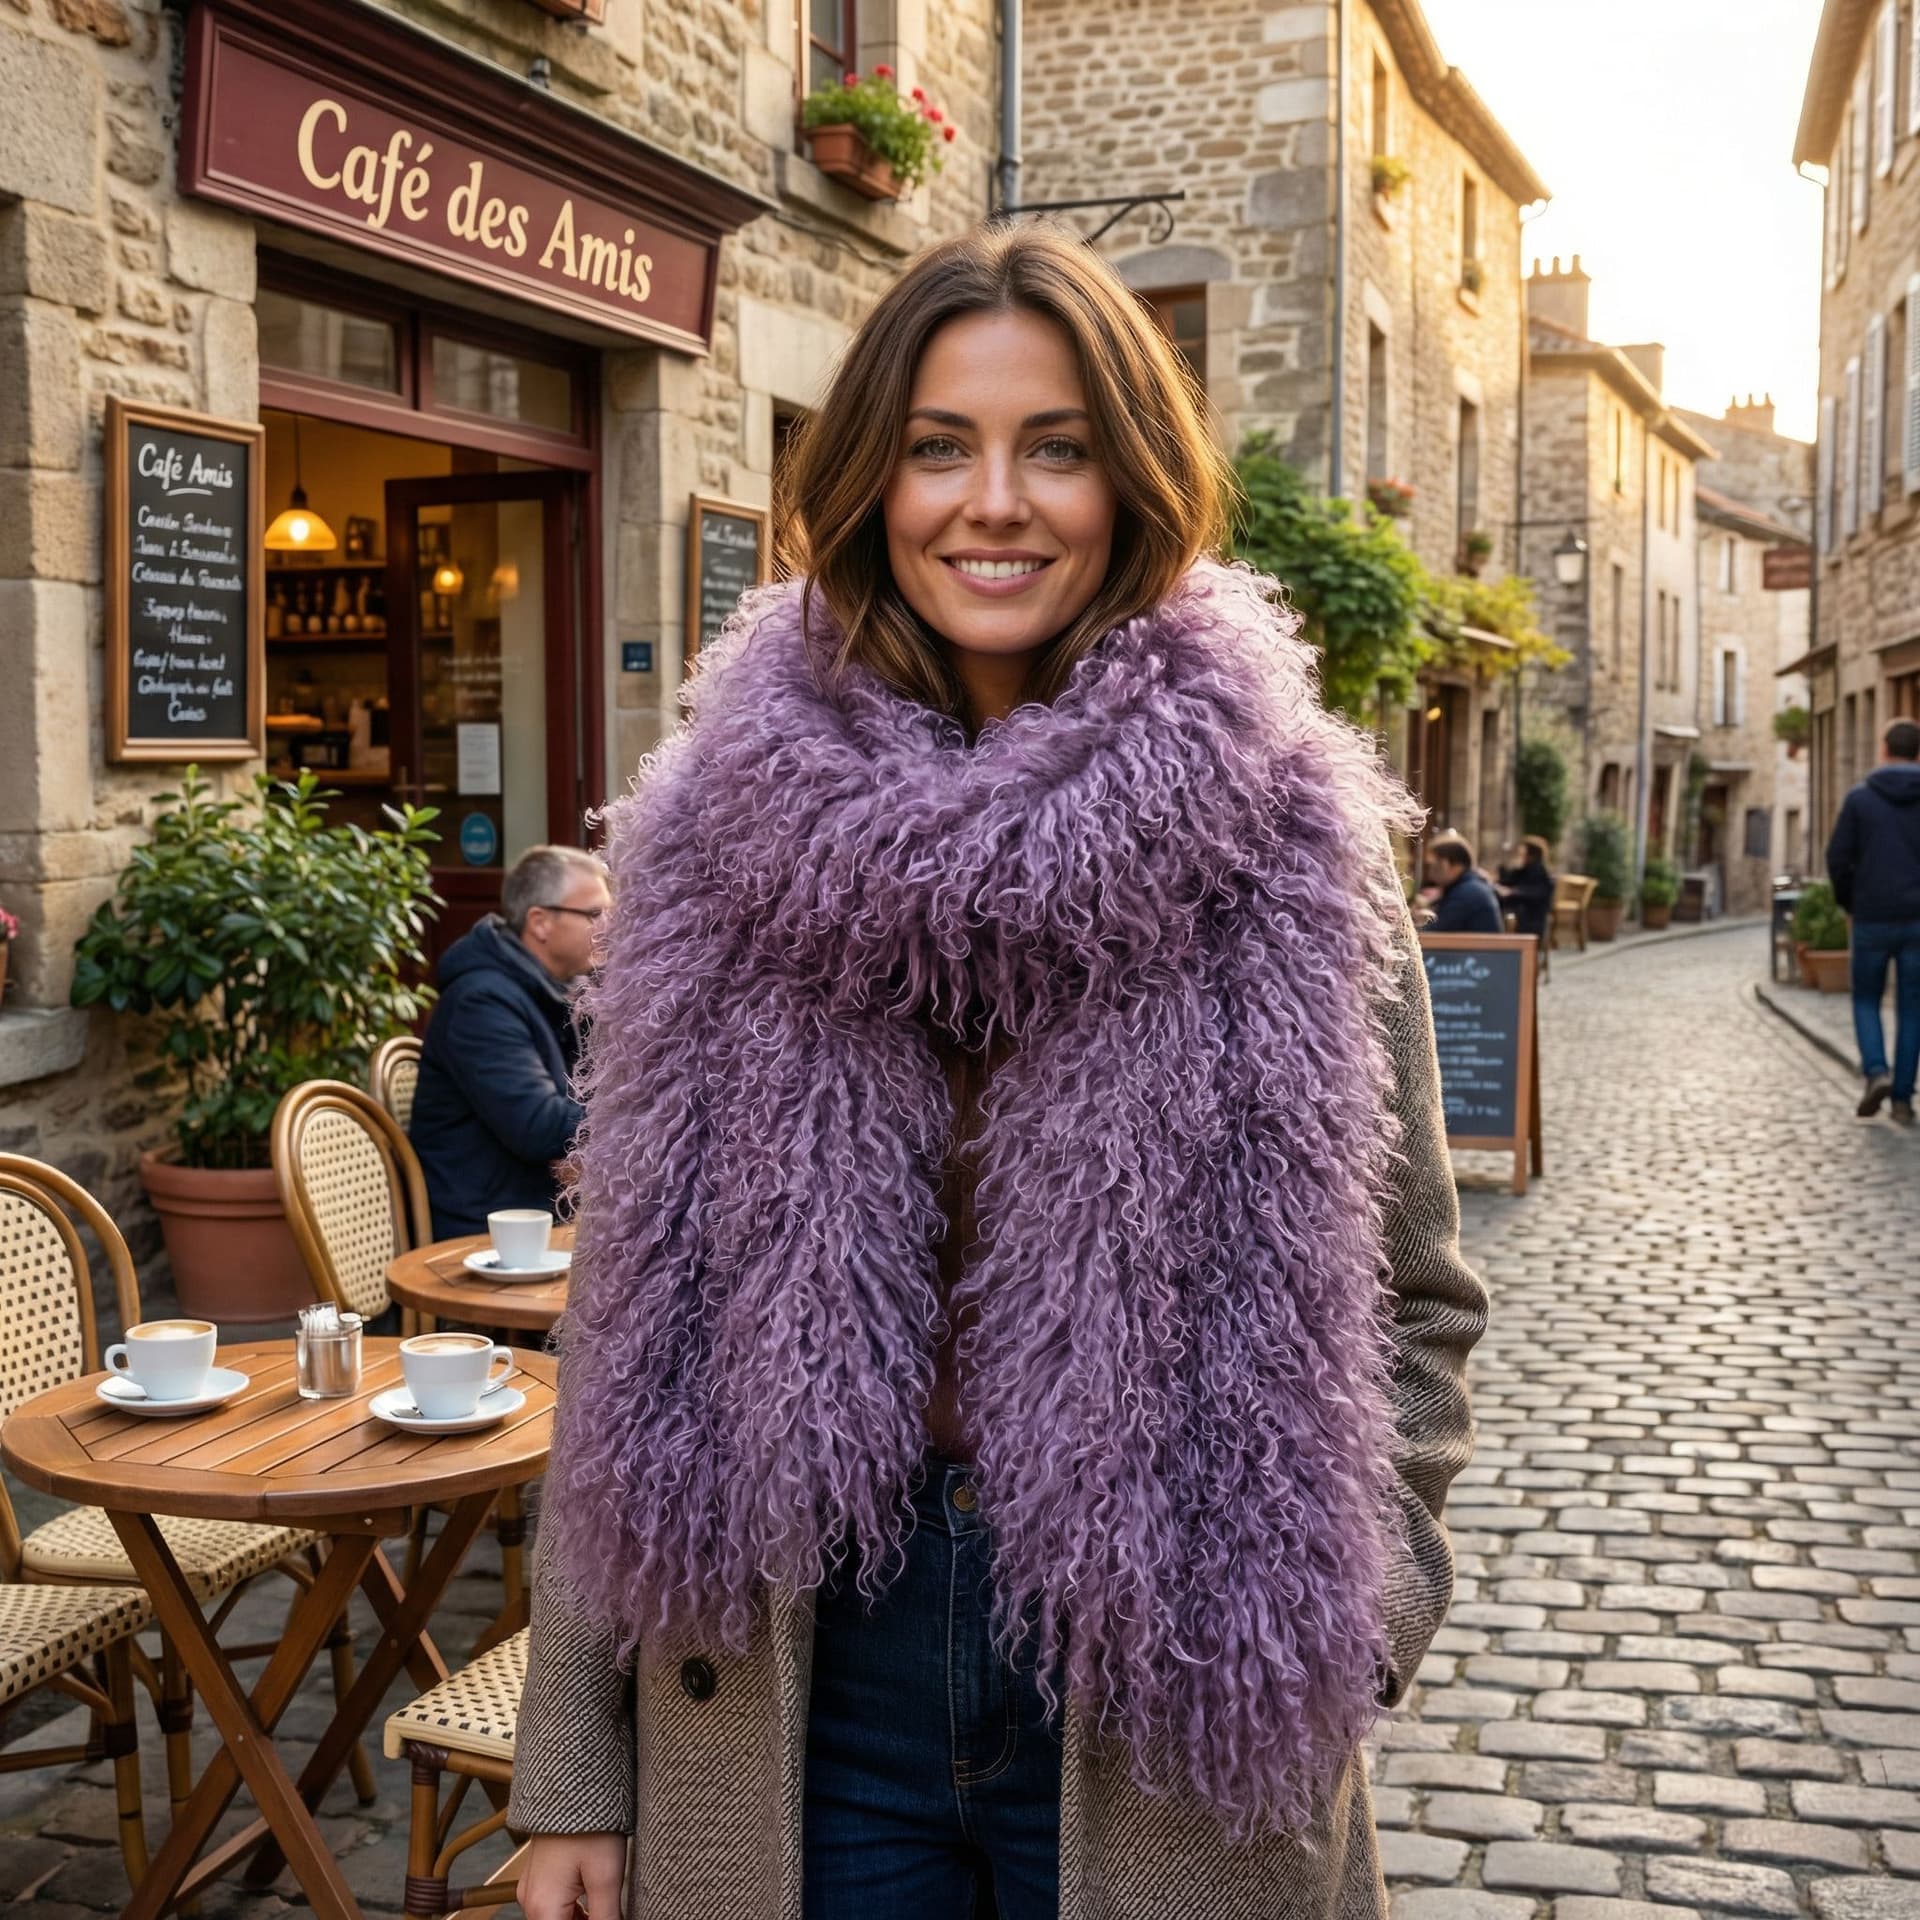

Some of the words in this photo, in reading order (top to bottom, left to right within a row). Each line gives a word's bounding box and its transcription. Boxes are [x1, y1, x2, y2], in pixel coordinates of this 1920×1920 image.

[297, 99, 434, 229] Café
[447, 161, 530, 258] des
[538, 199, 653, 303] Amis
[138, 443, 183, 490] Café
[187, 453, 233, 488] Amis
